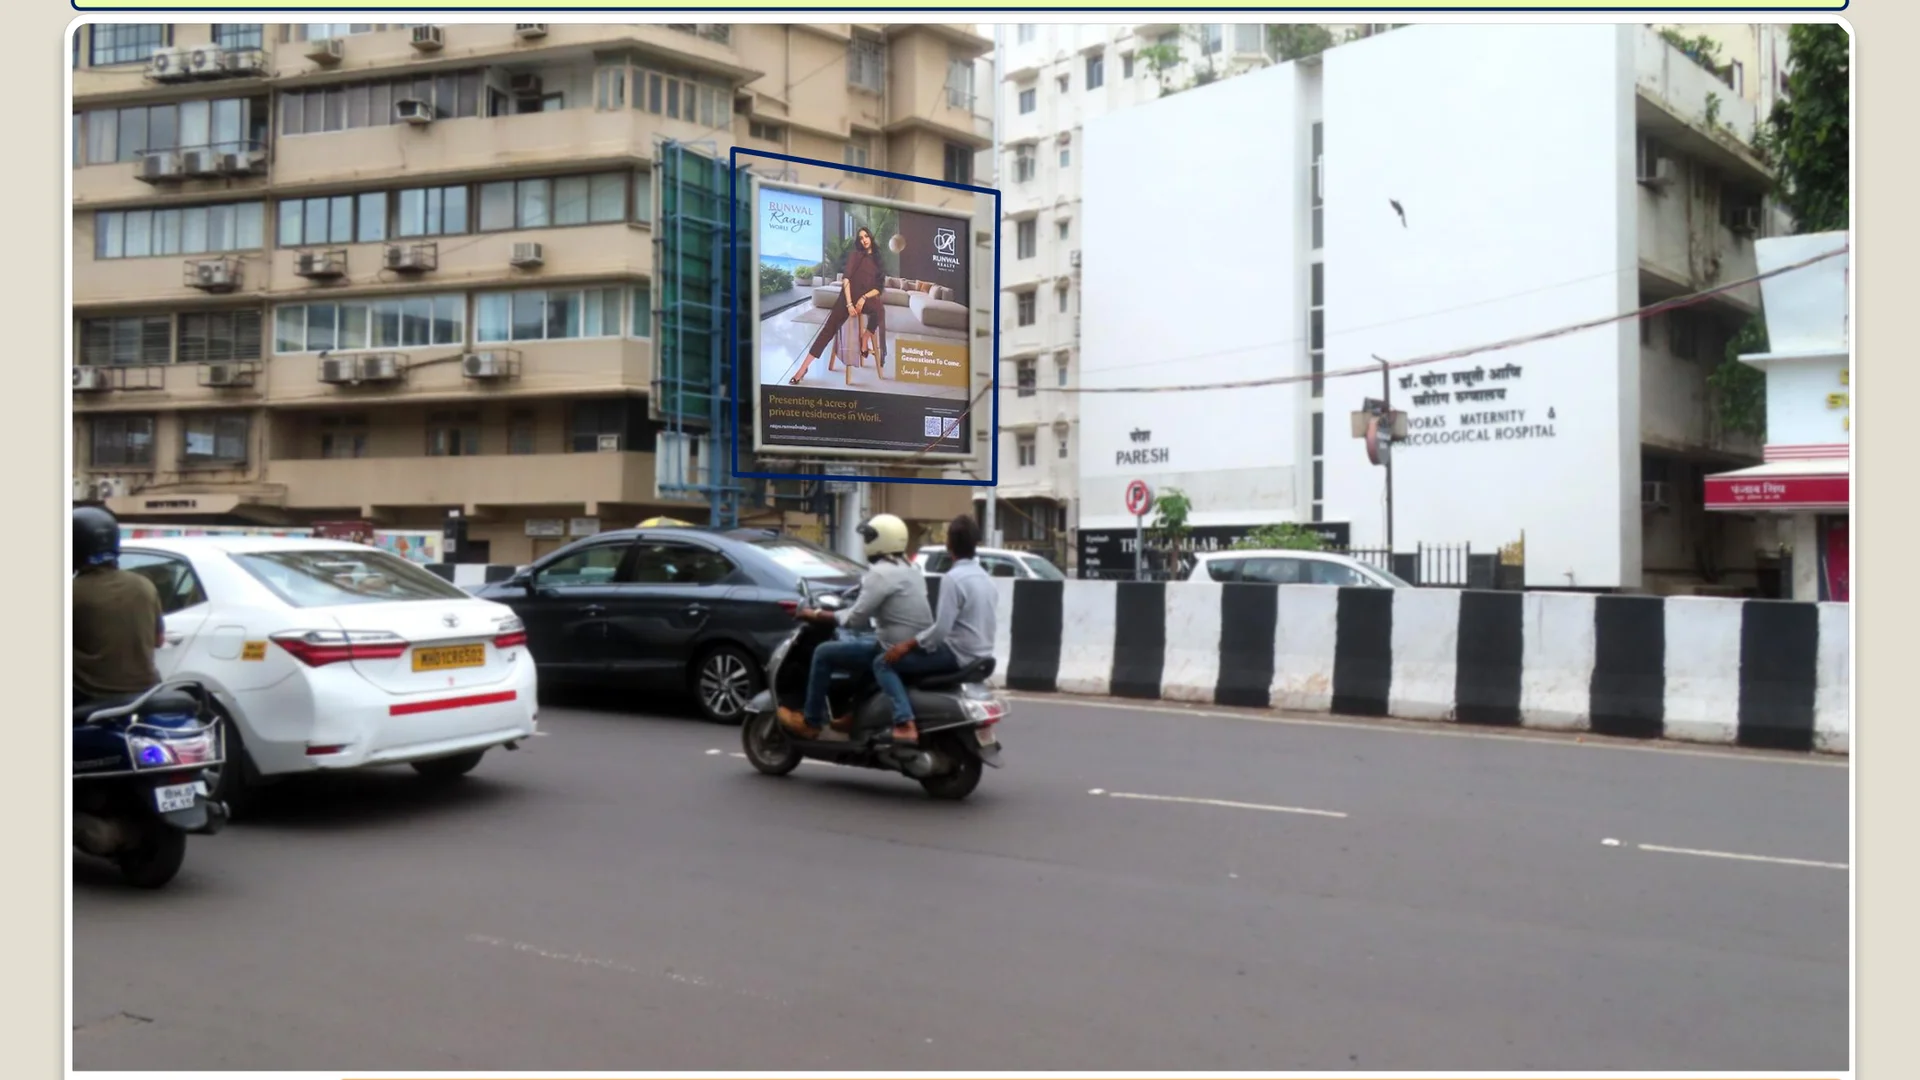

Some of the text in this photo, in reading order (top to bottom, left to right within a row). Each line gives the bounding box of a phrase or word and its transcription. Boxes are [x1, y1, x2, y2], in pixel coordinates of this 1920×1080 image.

[769, 201, 814, 216] RUNWAL
[770, 210, 812, 233] Raaya
[932, 254, 960, 265] RUNWAL
[901, 347, 934, 357] Building For
[901, 354, 961, 368] Generations To Come.
[1488, 362, 1522, 380] आणि
[769, 394, 858, 409] Presenting 4 acres of
[769, 407, 882, 423] private residences in Worli.
[1460, 409, 1526, 426] MATERNITY
[1546, 405, 1556, 420] &
[1495, 424, 1557, 442] HOSPITAL
[1116, 447, 1169, 466] PARESH
